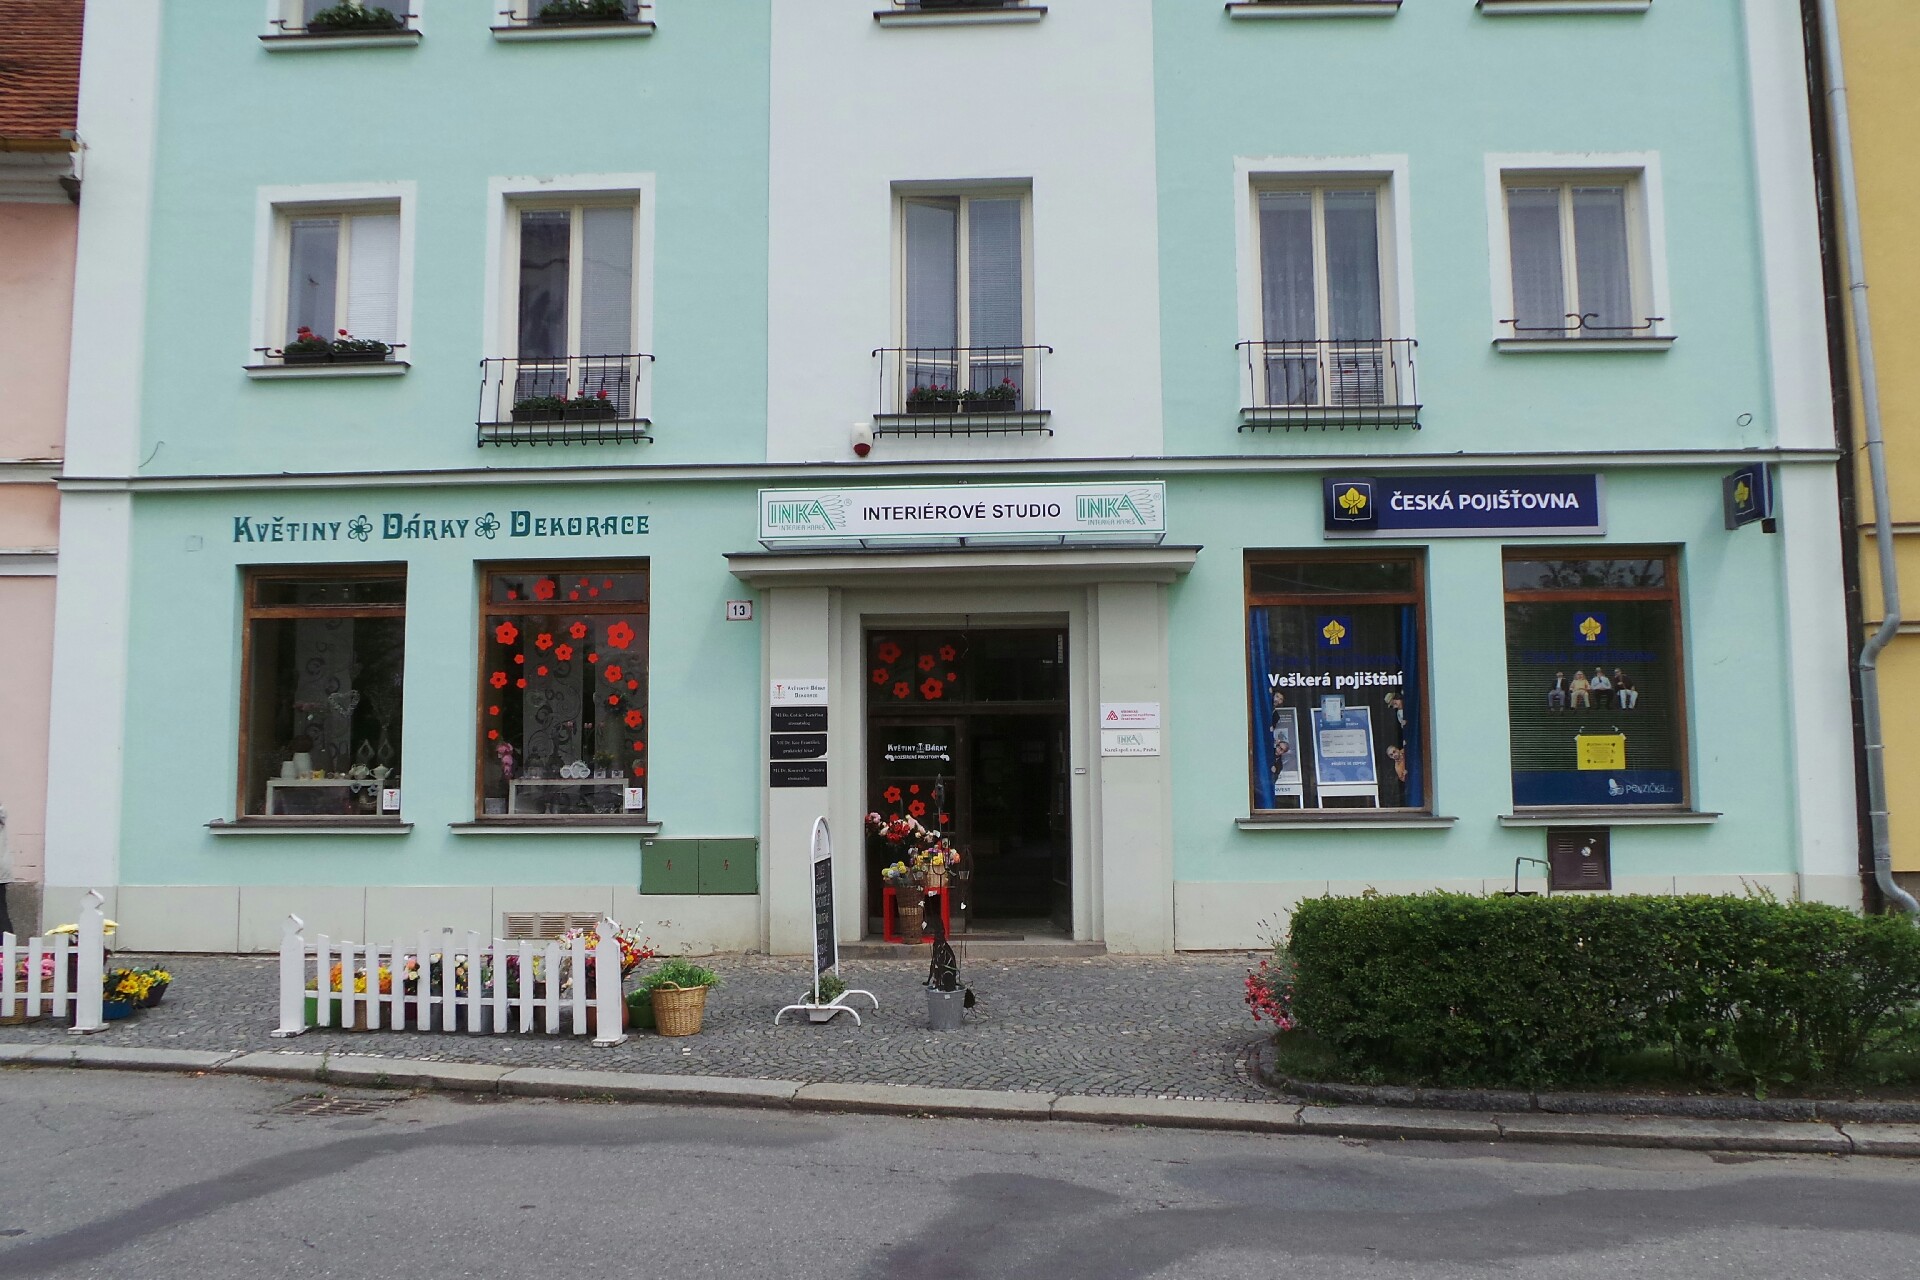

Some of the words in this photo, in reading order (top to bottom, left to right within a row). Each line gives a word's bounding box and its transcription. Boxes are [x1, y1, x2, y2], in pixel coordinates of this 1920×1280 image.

[863, 501, 986, 521] INTERIÉROVÉ
[992, 503, 1061, 518] STUDIO
[1079, 494, 1146, 525] INKA
[1390, 491, 1454, 511] ČESKÁ
[1459, 489, 1580, 512] POJIŠŤOVNA
[771, 500, 837, 531] INKA
[733, 604, 745, 616] 13
[1267, 671, 1331, 687] Veškerá
[1335, 670, 1404, 690] pojištění
